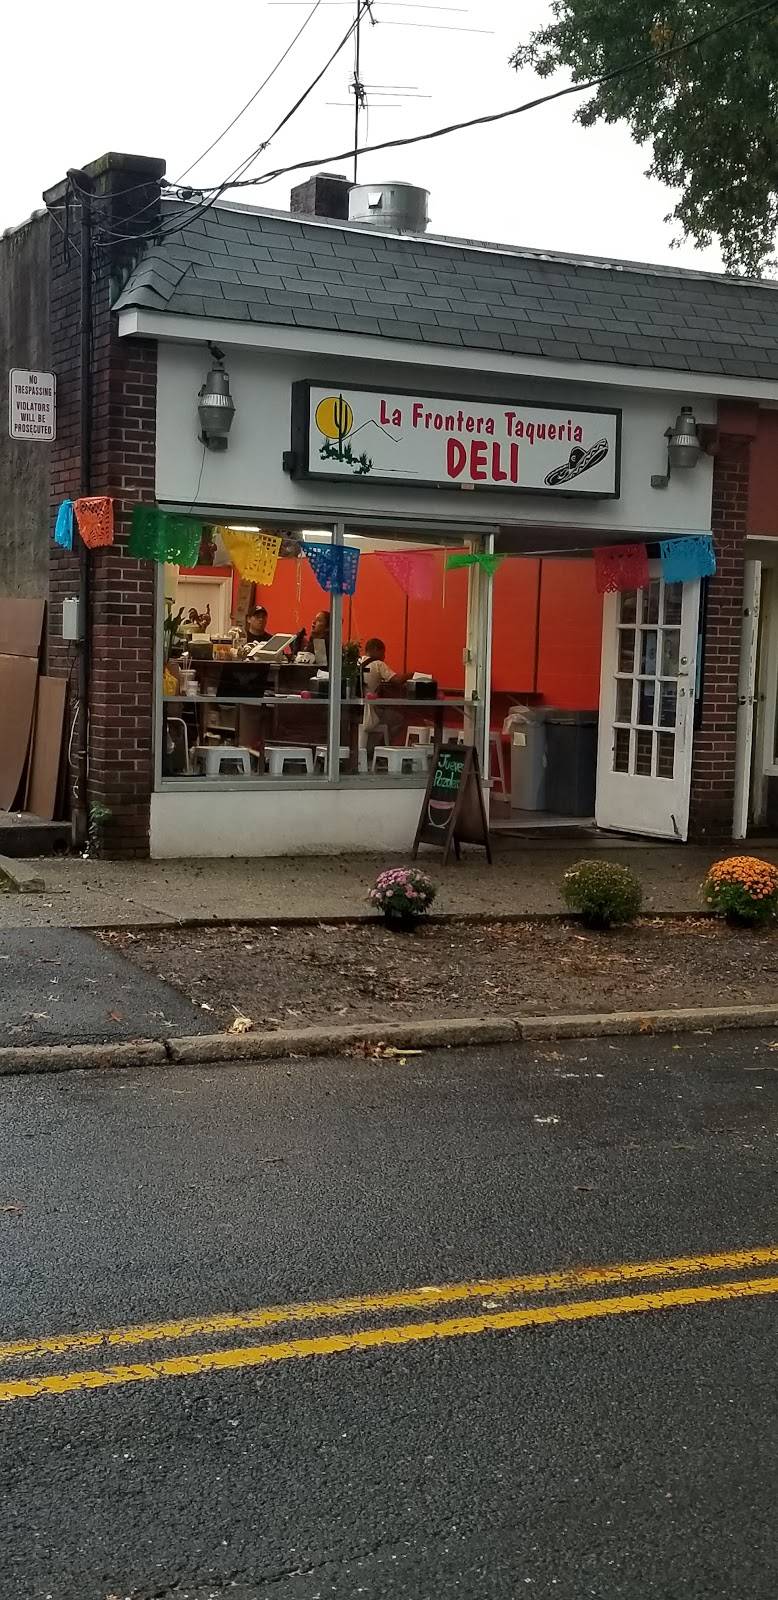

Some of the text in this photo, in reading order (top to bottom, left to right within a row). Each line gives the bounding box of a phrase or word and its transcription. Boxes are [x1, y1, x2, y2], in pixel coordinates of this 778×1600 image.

[29, 374, 38, 384] NO
[15, 385, 52, 396] TRESPASSING
[16, 402, 50, 412] VIOLATORS
[20, 412, 46, 423] WILL BE
[380, 399, 582, 445] La Frontera Taqueria
[14, 424, 52, 434] PROSECUTED
[446, 438, 519, 484] DELI
